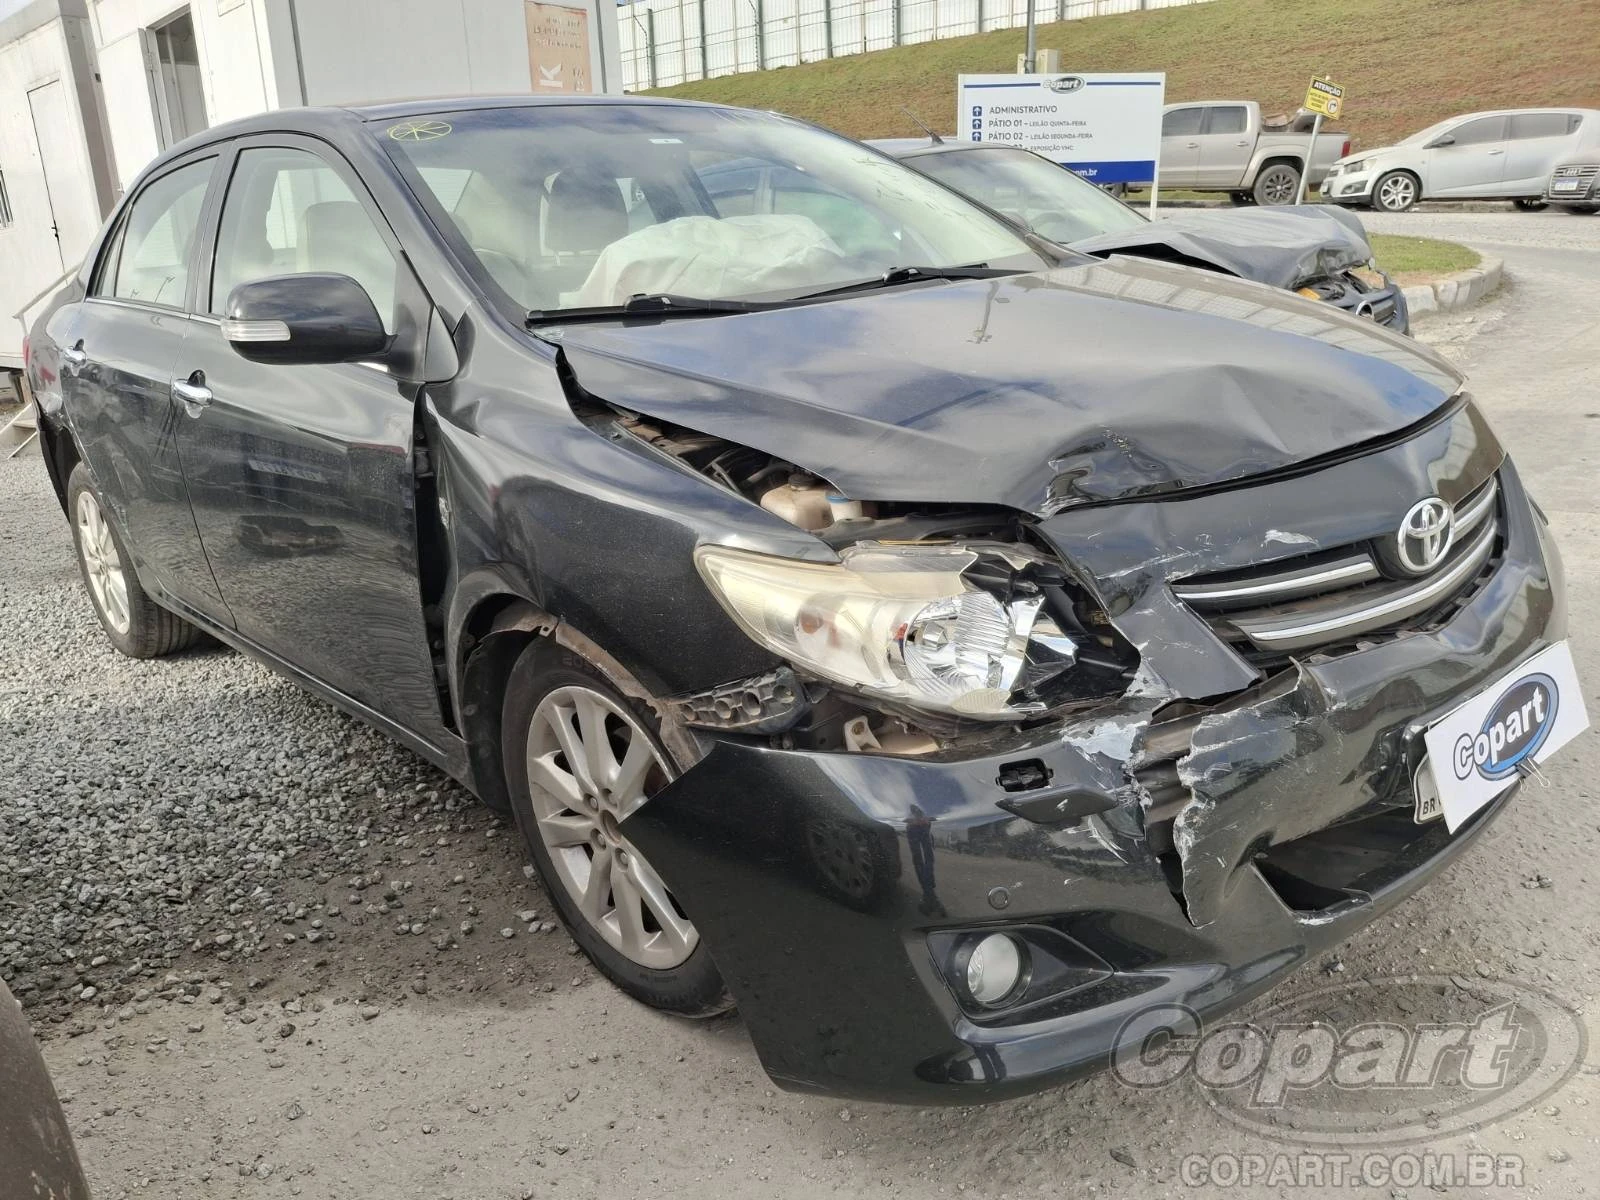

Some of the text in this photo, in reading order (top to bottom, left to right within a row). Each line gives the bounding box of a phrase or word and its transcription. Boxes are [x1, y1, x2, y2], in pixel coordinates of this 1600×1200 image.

[1313, 81, 1341, 97] ATENÇÃO
[989, 105, 1057, 114] ADMINISTRATIVO
[988, 118, 1011, 127] PÁTIO
[1013, 119, 1023, 127] 01
[988, 131, 1011, 140] PÁTIO
[1013, 132, 1023, 140] 02
[1453, 685, 1545, 781] Copart
[1422, 797, 1436, 815] BR
